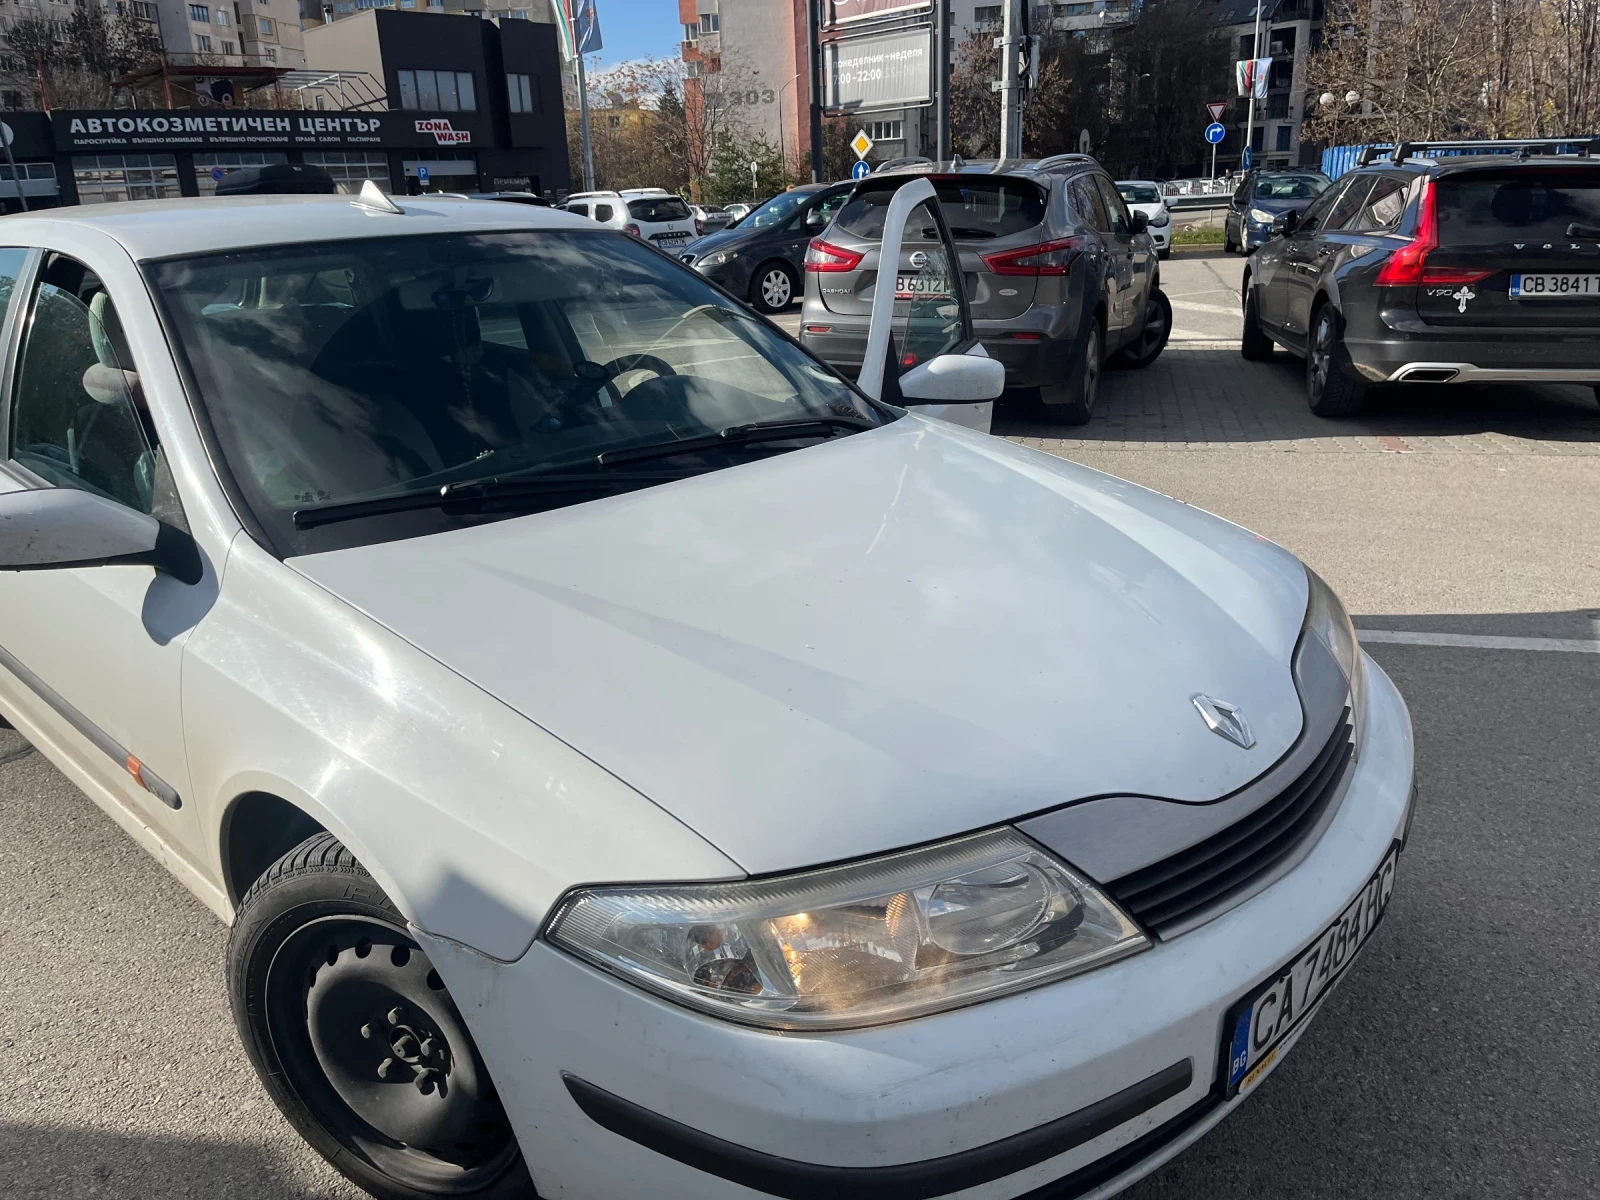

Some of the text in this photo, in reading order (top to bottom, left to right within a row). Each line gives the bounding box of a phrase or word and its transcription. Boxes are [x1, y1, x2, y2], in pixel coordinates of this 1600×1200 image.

[70, 117, 381, 135] АВТОКОЗМЕТИЧЕН ЦЕНТЪР
[417, 121, 450, 131] ZONA
[74, 136, 127, 145] ПАРОСТРУЙКА
[435, 132, 469, 142] WASH
[908, 276, 941, 292] 6312
[1523, 276, 1545, 293] CB
[1549, 276, 1589, 293] 3841
[1232, 862, 1392, 1076] BG CA 7484 HC
